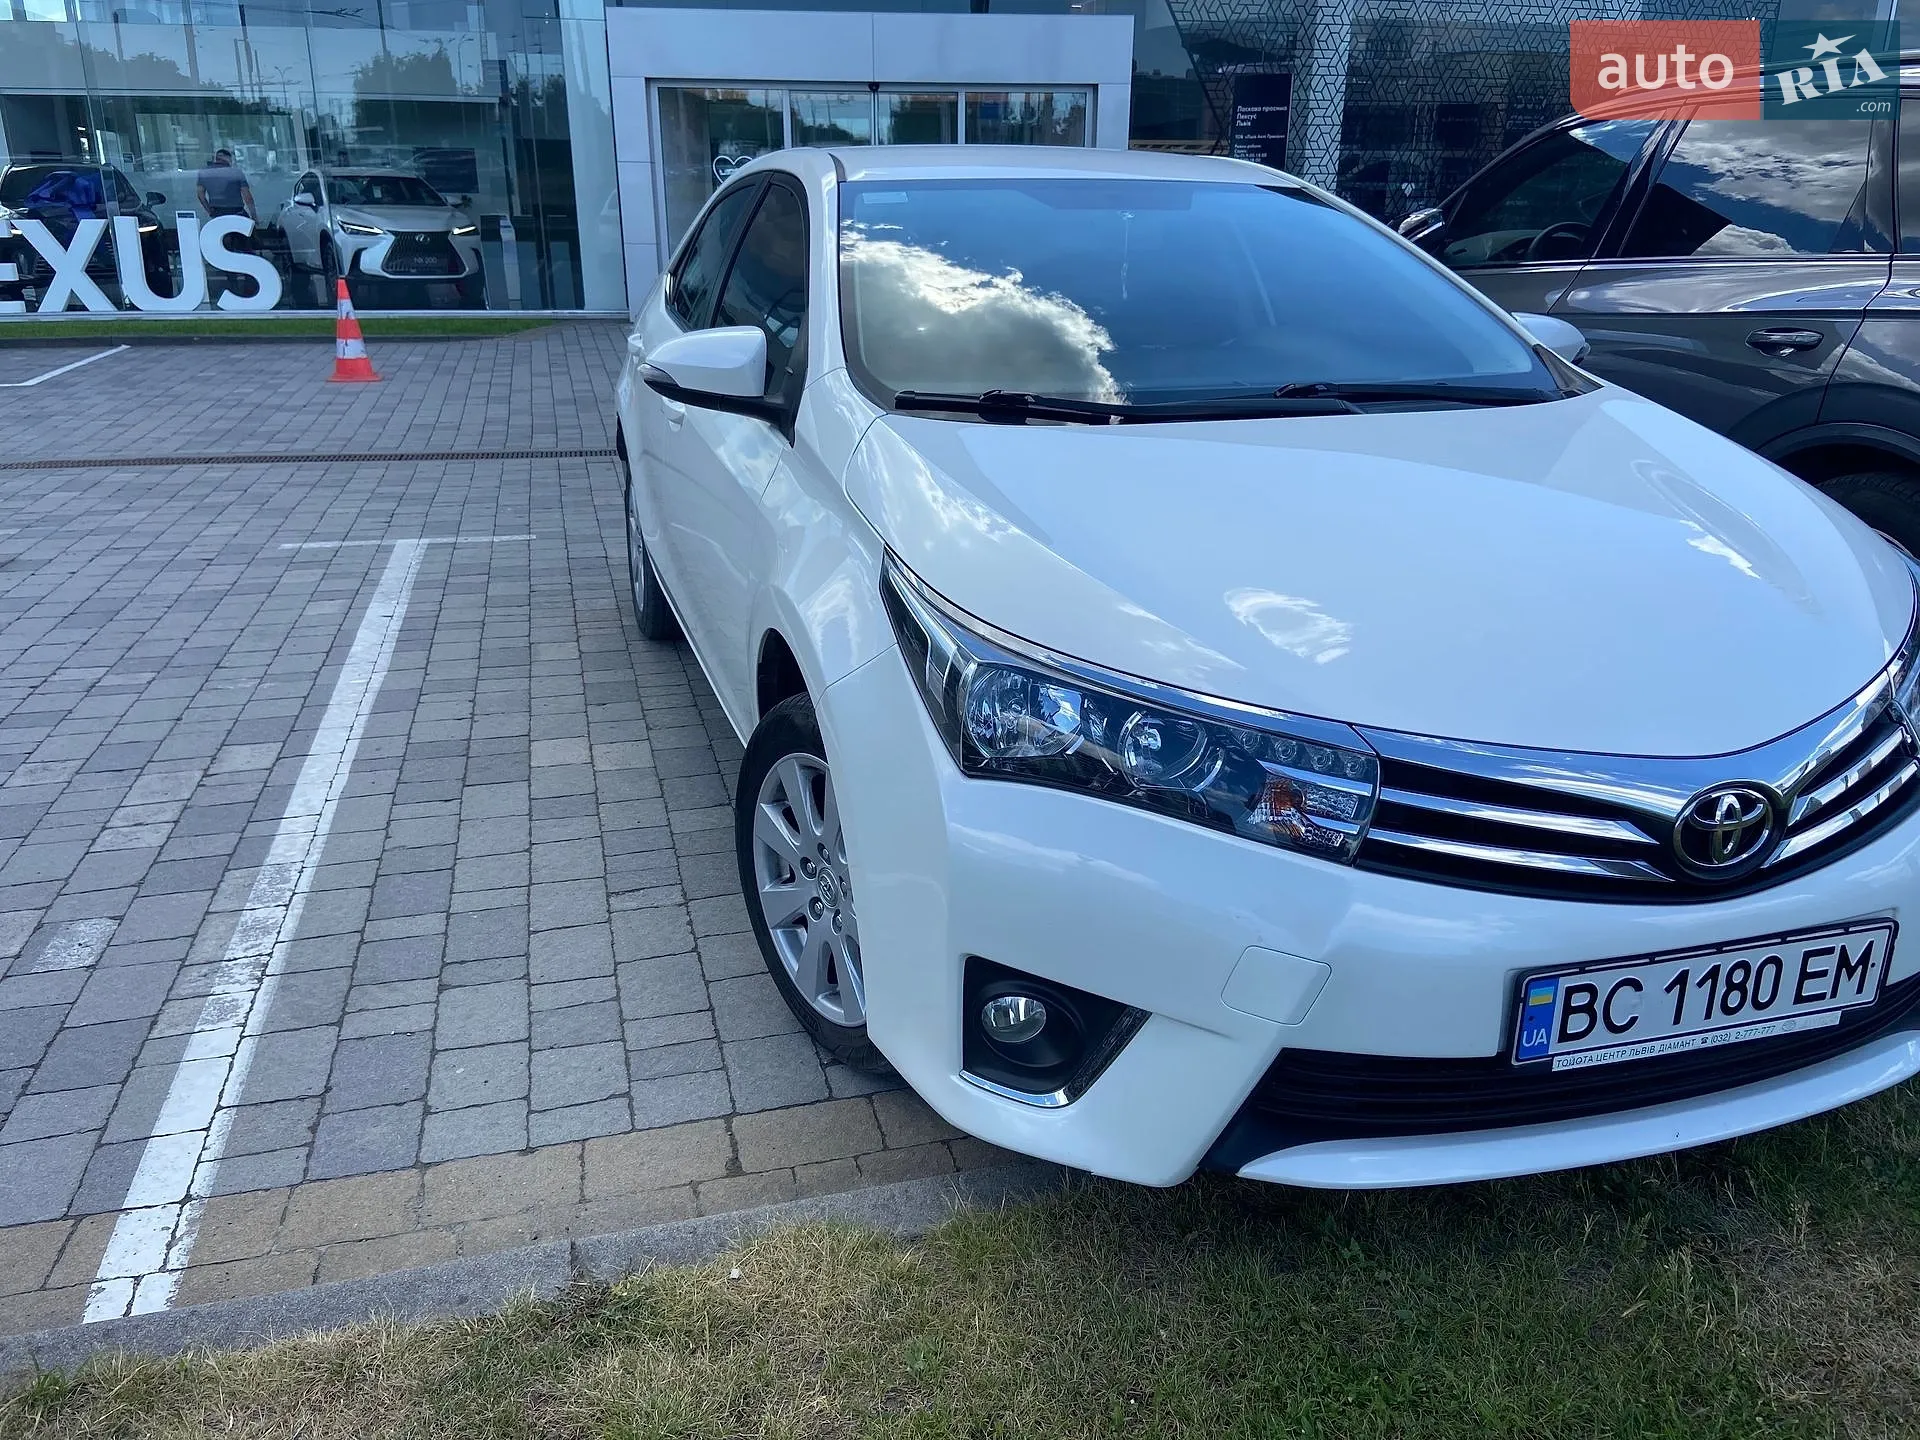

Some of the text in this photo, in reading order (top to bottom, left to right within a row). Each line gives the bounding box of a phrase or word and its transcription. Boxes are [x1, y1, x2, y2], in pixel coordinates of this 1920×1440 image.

[1556, 940, 1875, 1044] BC 1180 EM
[1521, 1028, 1548, 1048] UA
[1556, 1024, 1777, 1068] ТОЙОТА ЦЕНТР ЛЬВІВ ДІАМАНТ (032) 2-777-777
